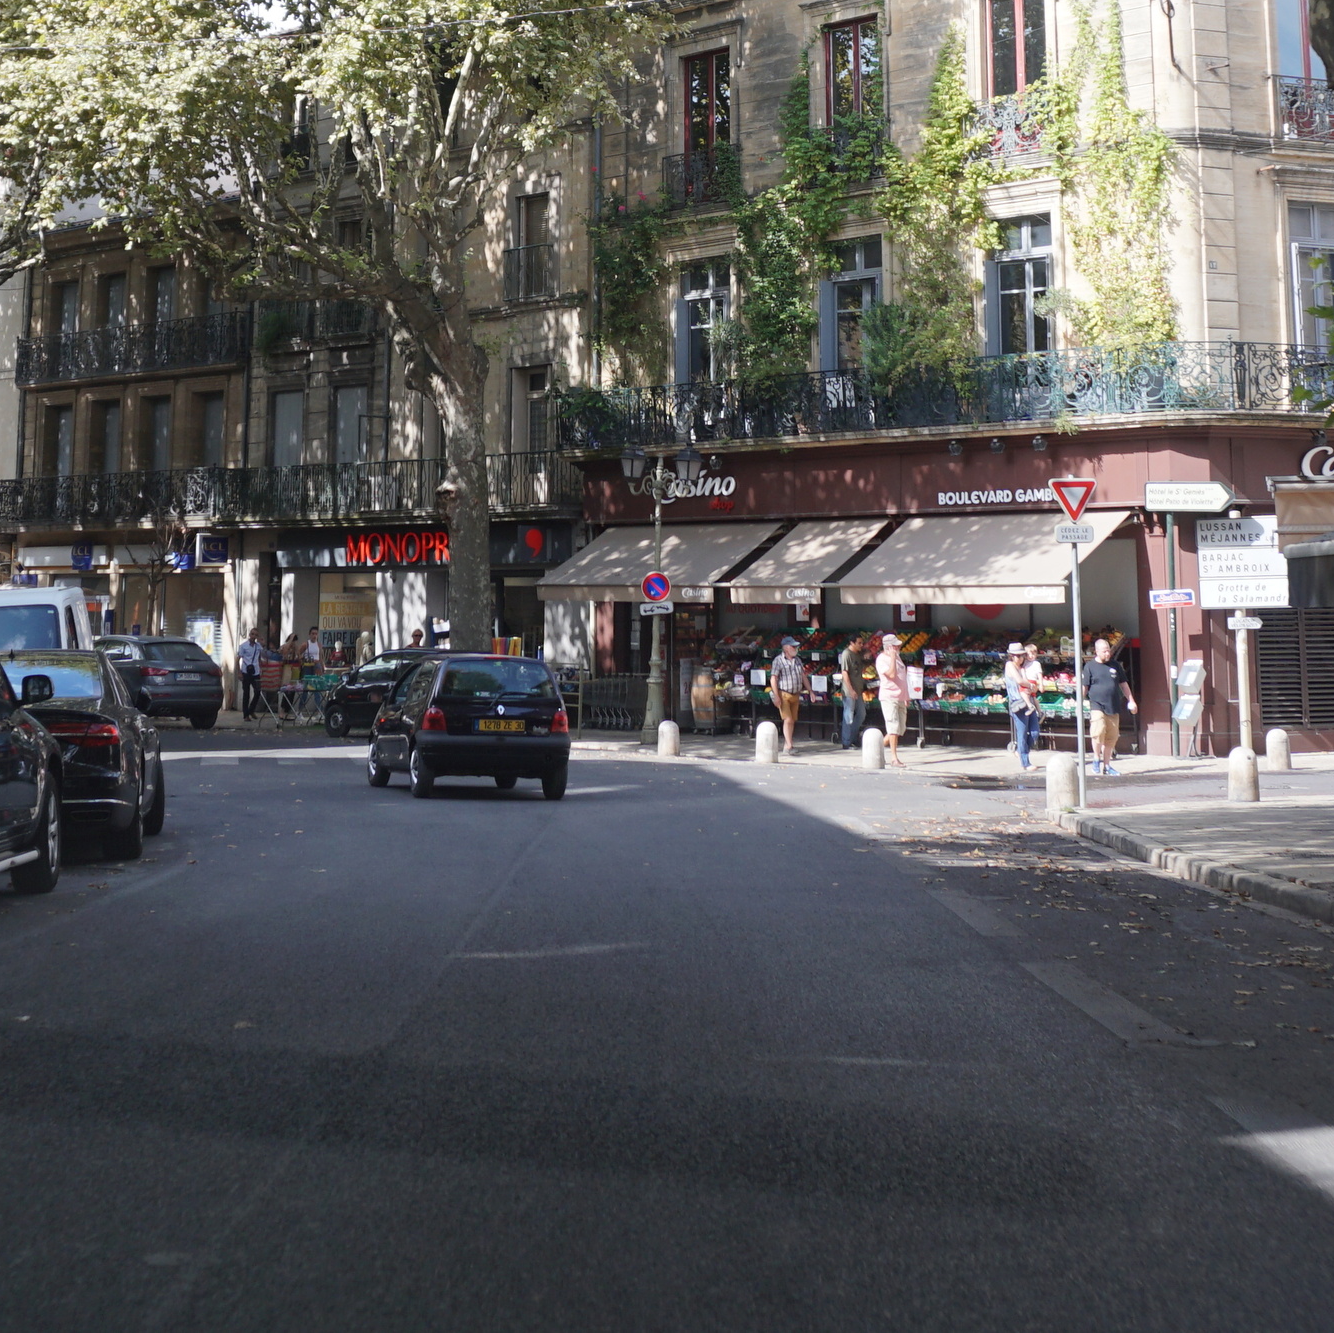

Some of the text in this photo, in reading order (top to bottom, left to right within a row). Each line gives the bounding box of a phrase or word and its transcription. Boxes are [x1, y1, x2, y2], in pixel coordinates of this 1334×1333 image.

[938, 488, 1059, 505] BOULEVARD GAMB
[1060, 526, 1080, 534] CÉDEZ
[1199, 522, 1242, 532] LUSSAN
[1200, 532, 1260, 543] MÉJANNES
[71, 546, 90, 556] LCL
[203, 542, 225, 551] LCL
[346, 531, 450, 563] MONOPR
[1202, 553, 1244, 562] BARJAC
[1218, 563, 1270, 573] AMBROIX
[1218, 583, 1267, 592] Grotte de
[681, 587, 708, 599] Casino
[786, 587, 815, 599] Casino
[1218, 594, 1287, 603] la Salamandr
[322, 603, 333, 615] LA
[322, 616, 336, 630] QUI
[337, 616, 347, 628] VA
[322, 631, 347, 645] FAIRE
[503, 720, 513, 730] ZE
[515, 721, 525, 730] 30
